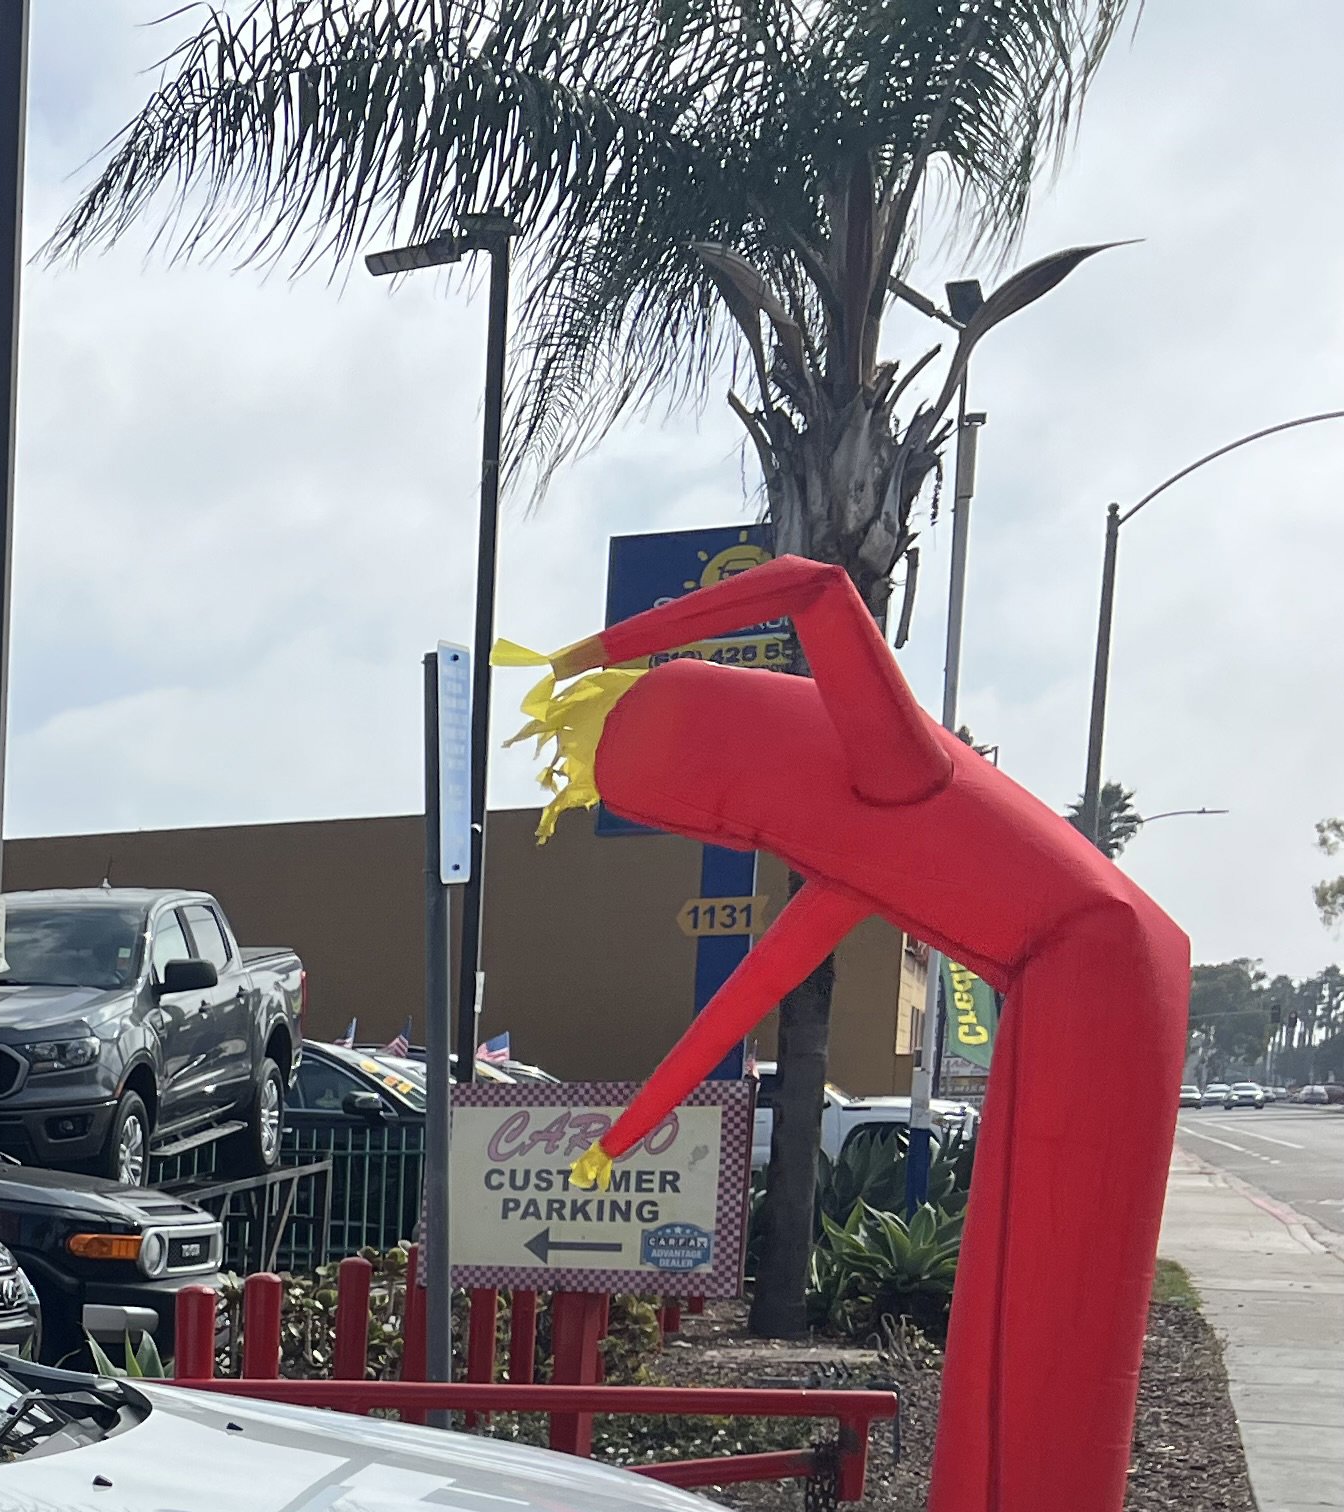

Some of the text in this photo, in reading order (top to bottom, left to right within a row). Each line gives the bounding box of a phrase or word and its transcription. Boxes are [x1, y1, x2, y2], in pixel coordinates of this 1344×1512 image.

[687, 903, 752, 929] 1131
[487, 1109, 680, 1162] CARO
[484, 1167, 682, 1194] CUSTMER
[501, 1198, 660, 1223] PARKING
